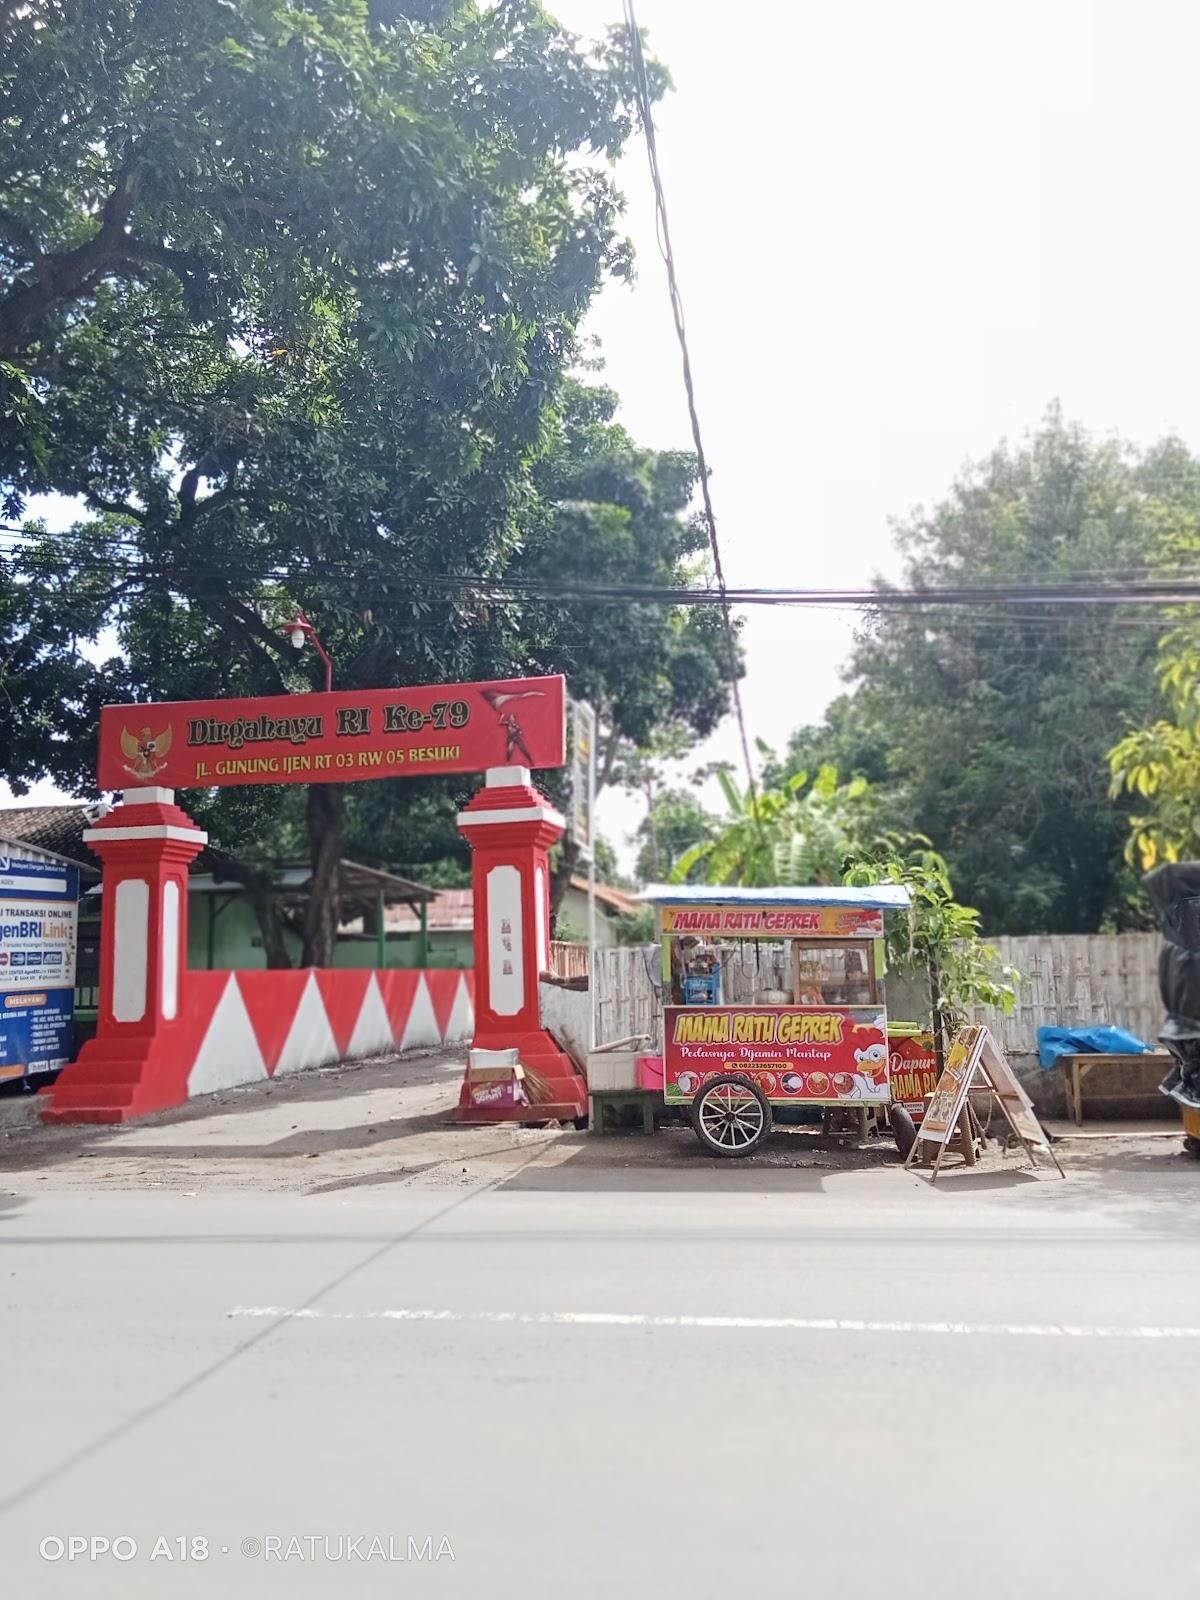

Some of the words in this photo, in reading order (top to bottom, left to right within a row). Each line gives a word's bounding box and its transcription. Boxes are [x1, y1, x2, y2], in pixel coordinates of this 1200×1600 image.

[188, 714, 324, 748] Dirgahayu
[336, 708, 371, 735] RI
[384, 699, 469, 731] Ke-79
[196, 762, 212, 779] JL.
[215, 757, 279, 775] GUNUNG
[283, 755, 310, 774] IJEN
[315, 754, 332, 769] RT
[336, 752, 354, 768] 03
[358, 751, 383, 766] RW
[386, 749, 404, 764] 05
[409, 745, 460, 762] BESUKI
[5, 908, 46, 917] TRANSAKSI
[48, 910, 72, 919] ONLINE
[674, 911, 721, 930] MAMA
[724, 911, 762, 930] RATU
[764, 911, 820, 930] GEPREK
[675, 1013, 730, 1044] MAMA
[732, 1013, 775, 1043] RATU
[777, 1013, 843, 1044] GEPREK
[680, 1047, 736, 1062] Pedasnya
[740, 1047, 782, 1062] Dijamin
[786, 1047, 832, 1062] Mantap
[890, 1052, 936, 1074] Dapur
